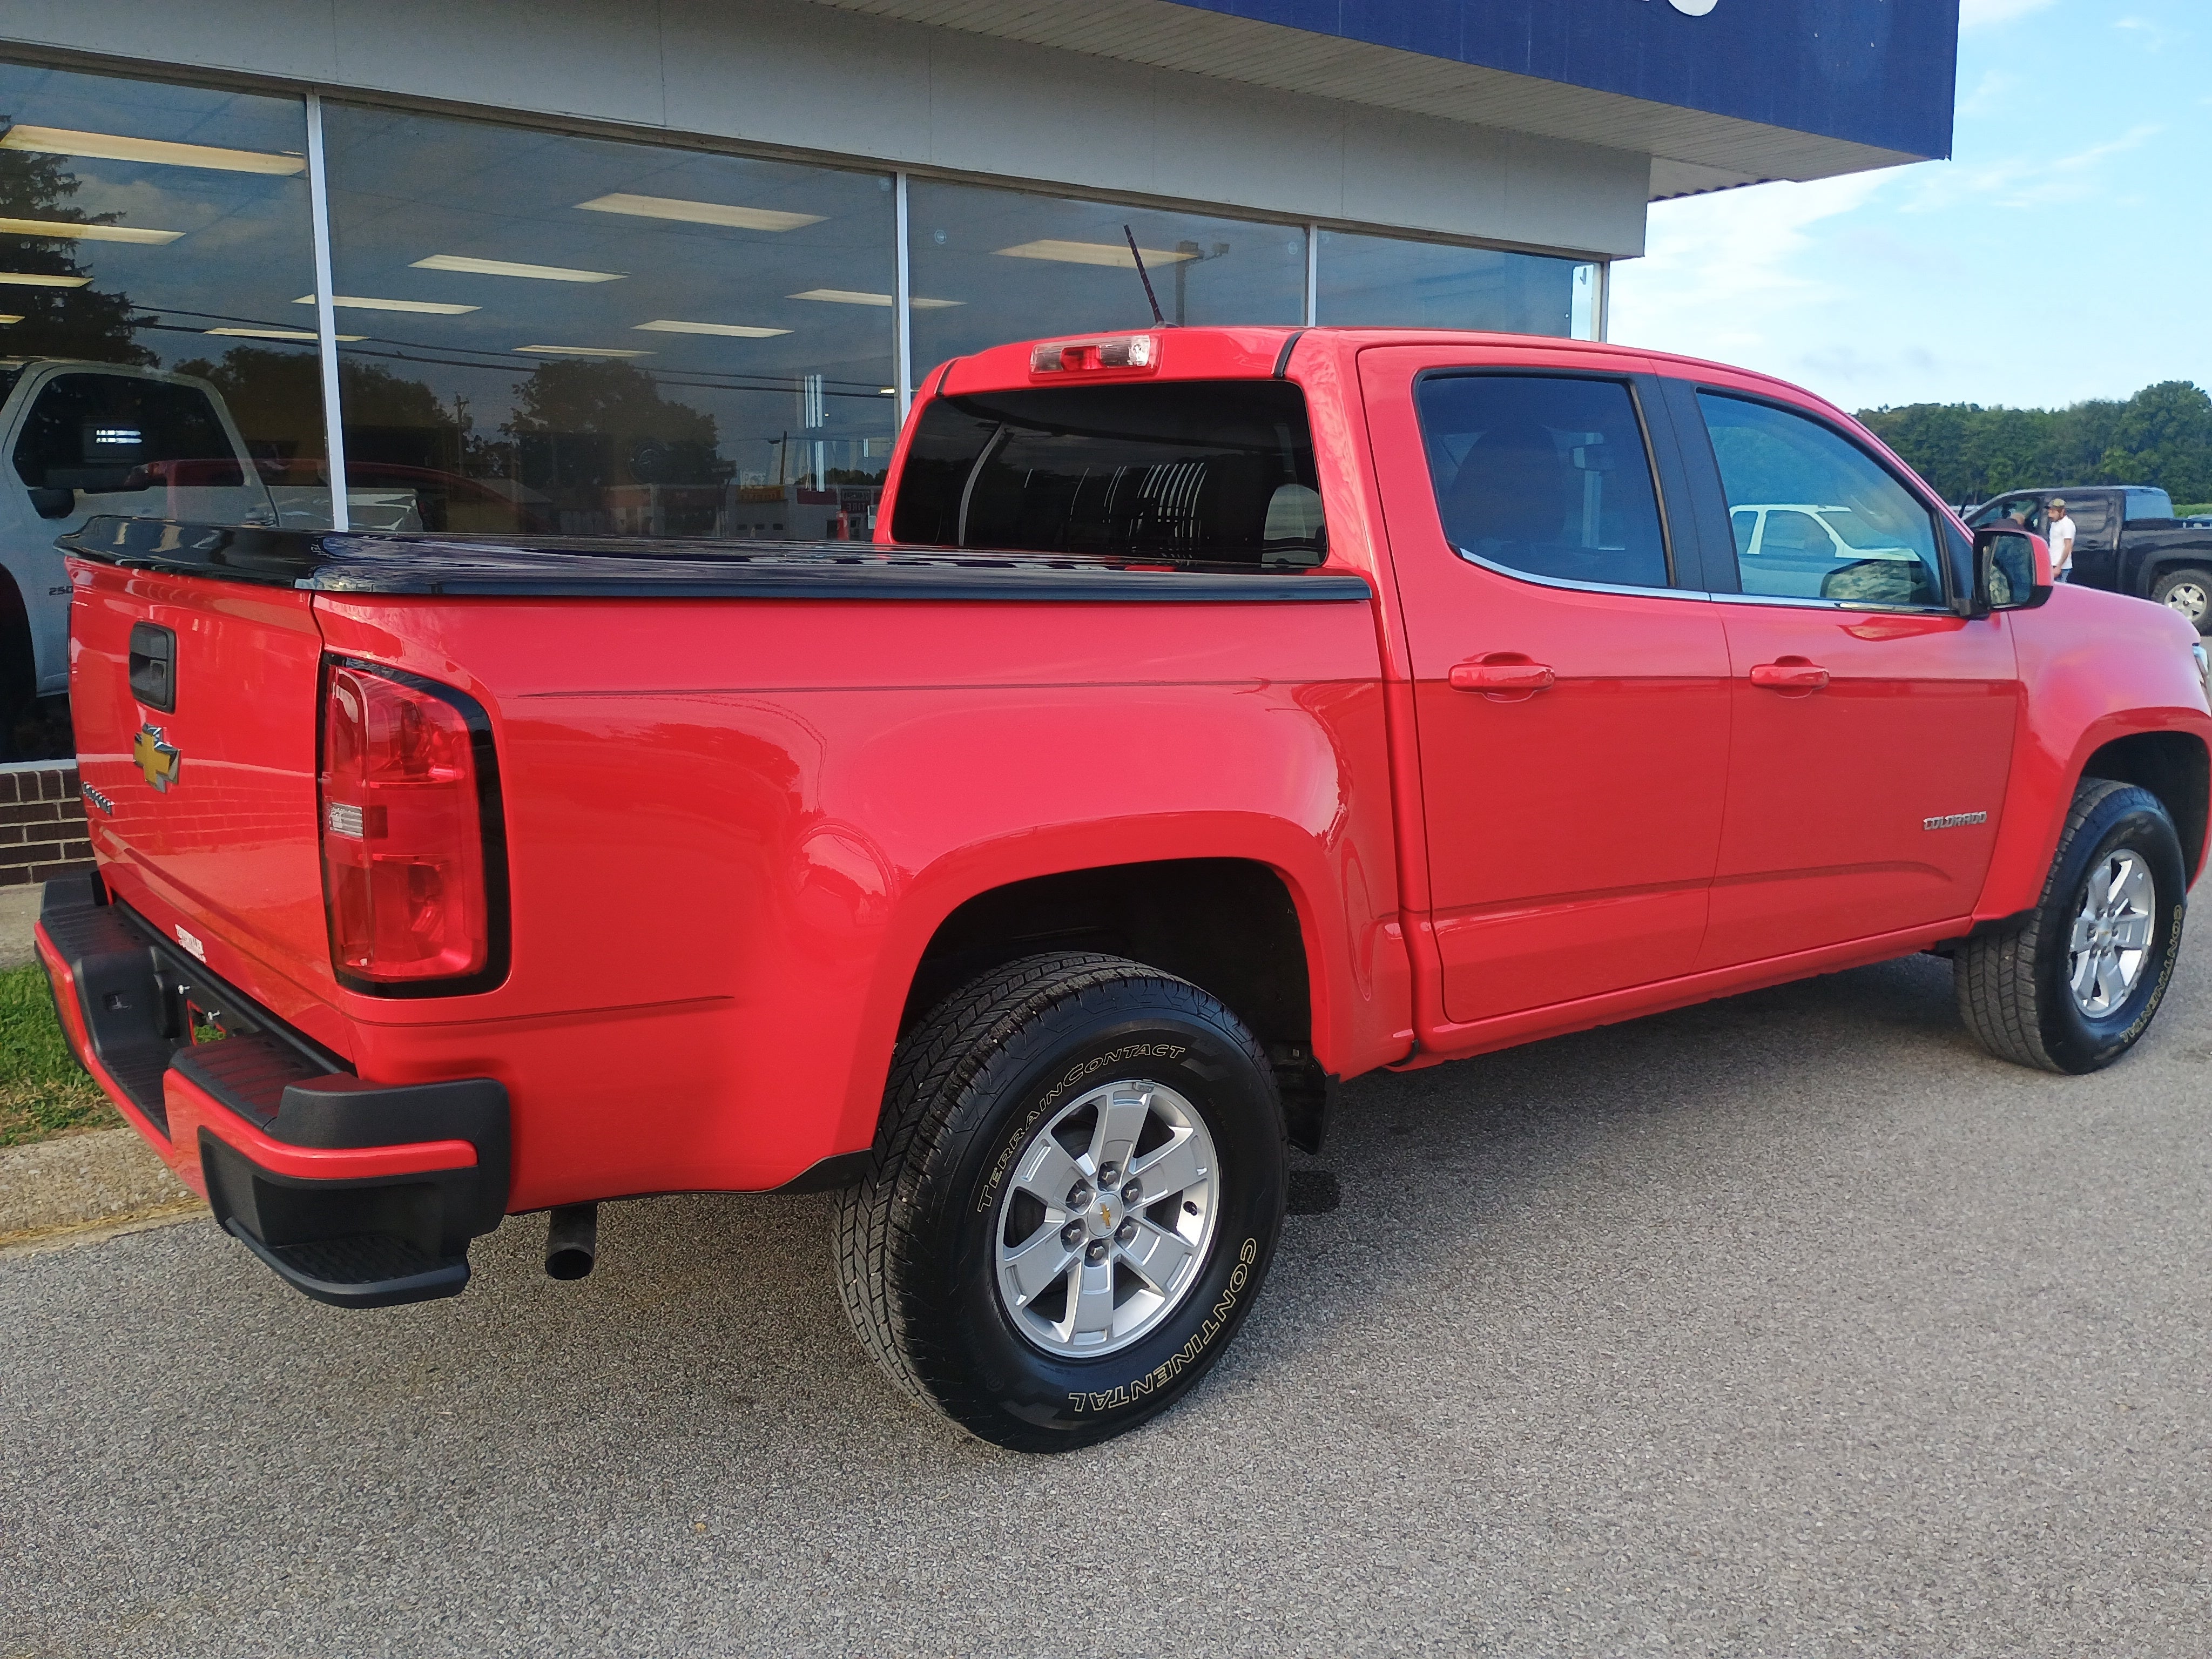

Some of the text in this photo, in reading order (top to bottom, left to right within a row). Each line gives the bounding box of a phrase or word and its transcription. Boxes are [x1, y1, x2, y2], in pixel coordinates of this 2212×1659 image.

[1923, 811, 1987, 831] COLORADO
[976, 1043, 1186, 1213] TERRAINCONTACT
[1068, 1238, 1257, 1413] CONTINENTAL
